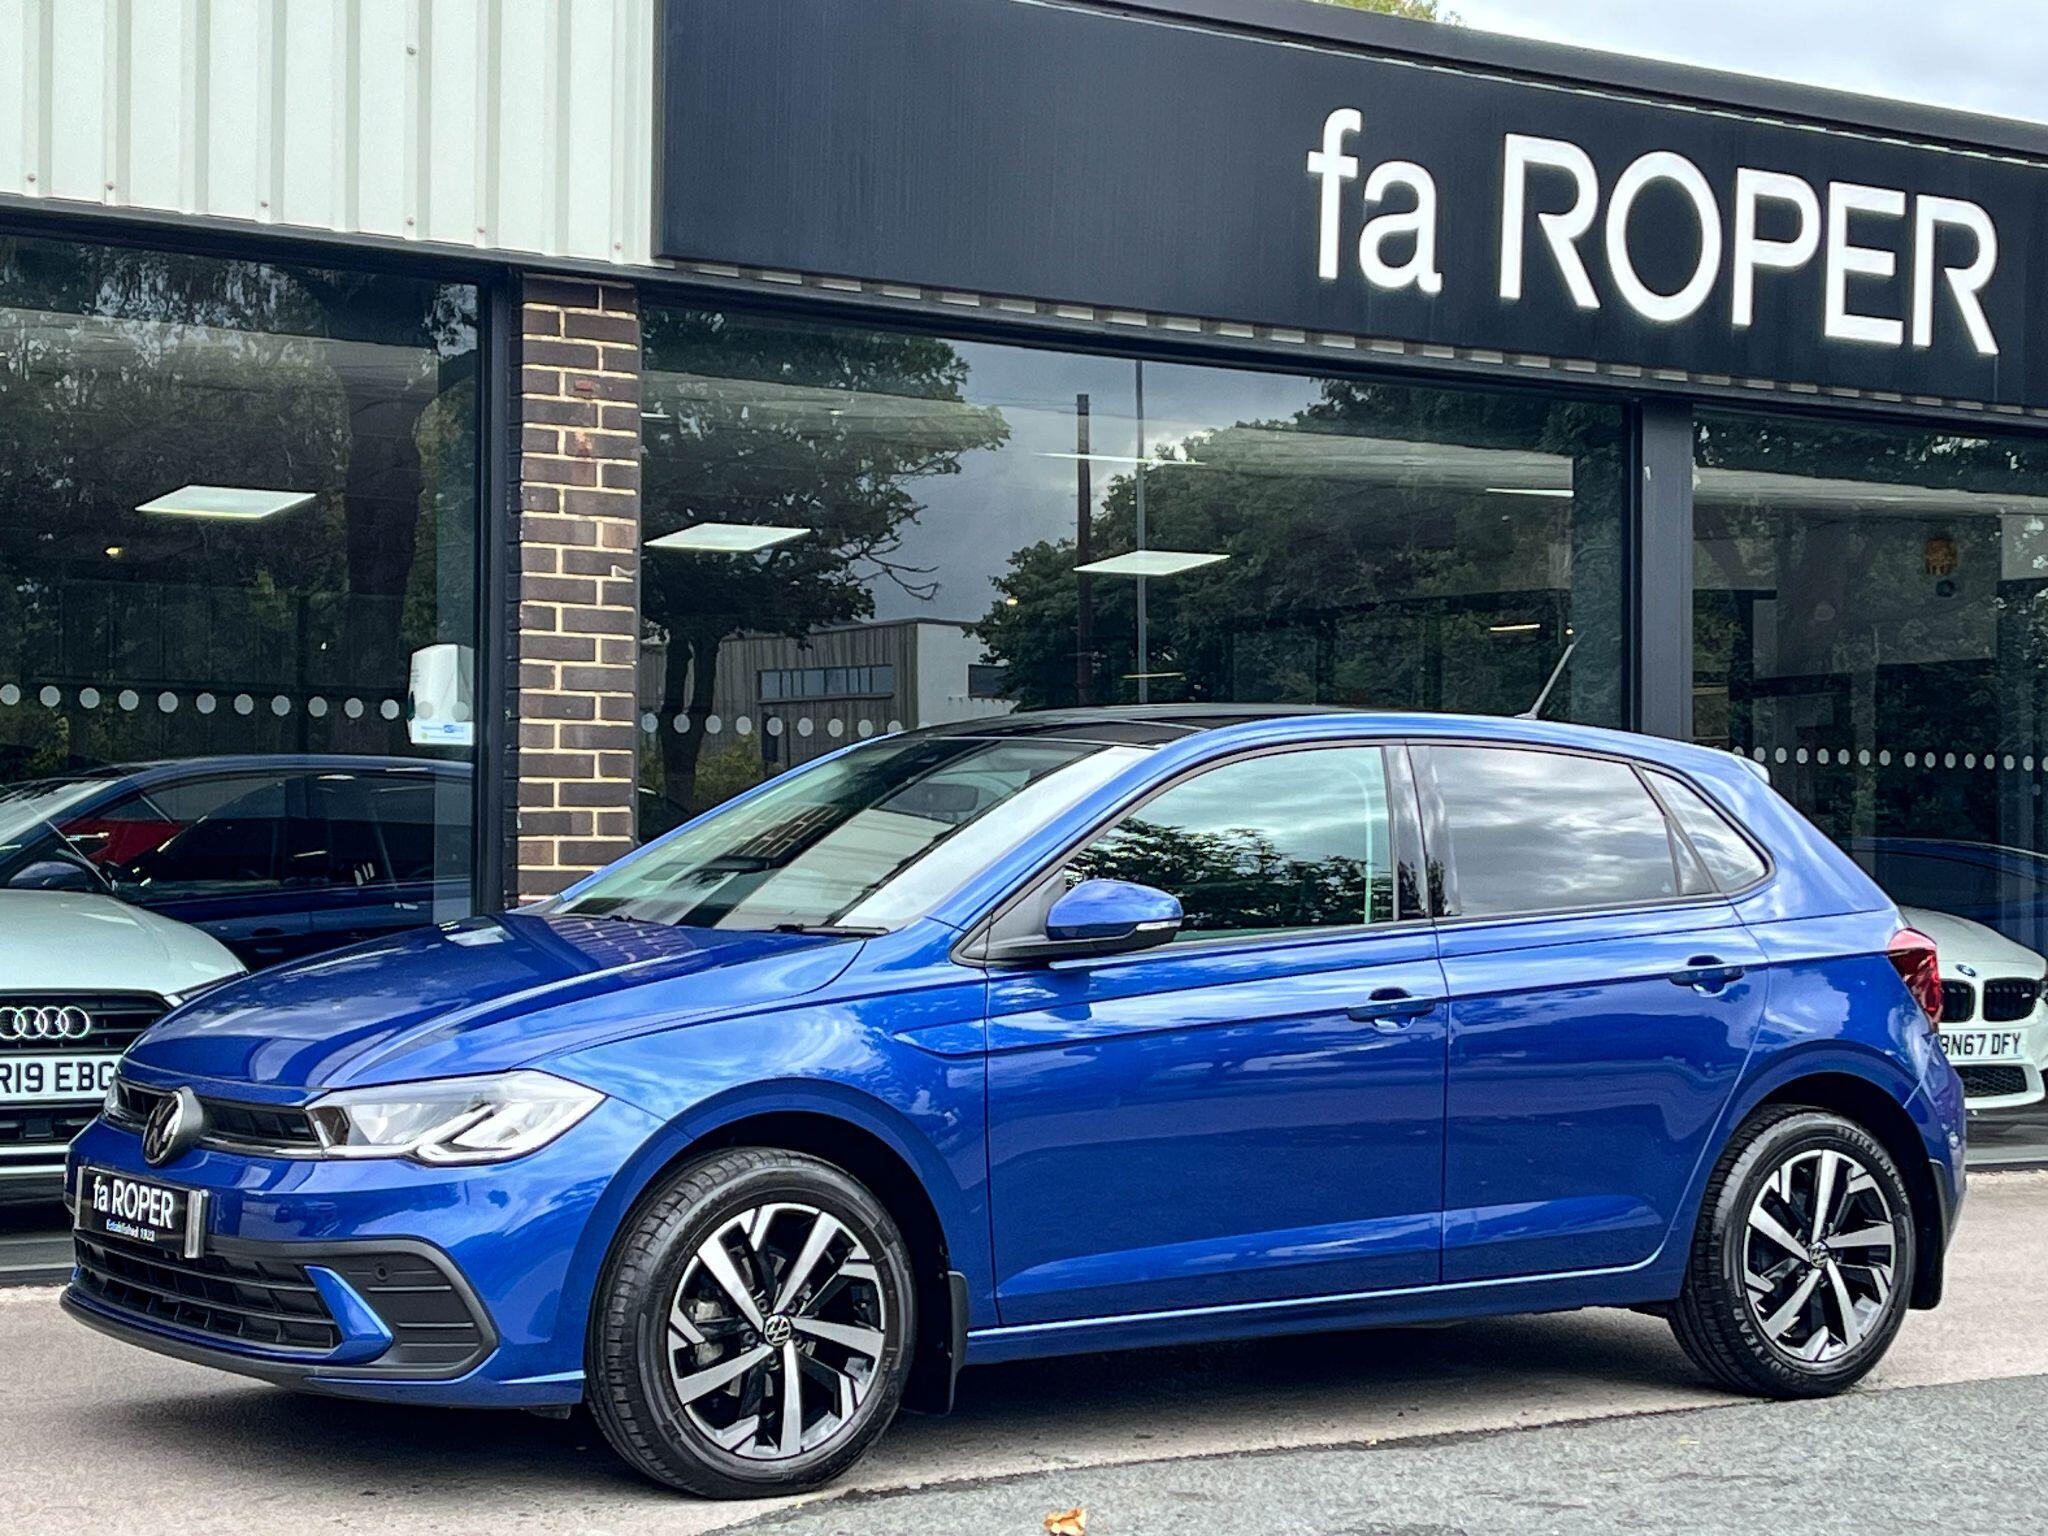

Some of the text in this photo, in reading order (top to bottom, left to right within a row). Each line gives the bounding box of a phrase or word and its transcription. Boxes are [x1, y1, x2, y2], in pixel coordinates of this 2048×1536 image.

[1307, 108, 1999, 356] fa ROPER
[1991, 1032, 2021, 1055] DFY
[55, 1061, 115, 1092] EBG
[93, 1175, 174, 1229] fa ROPER
